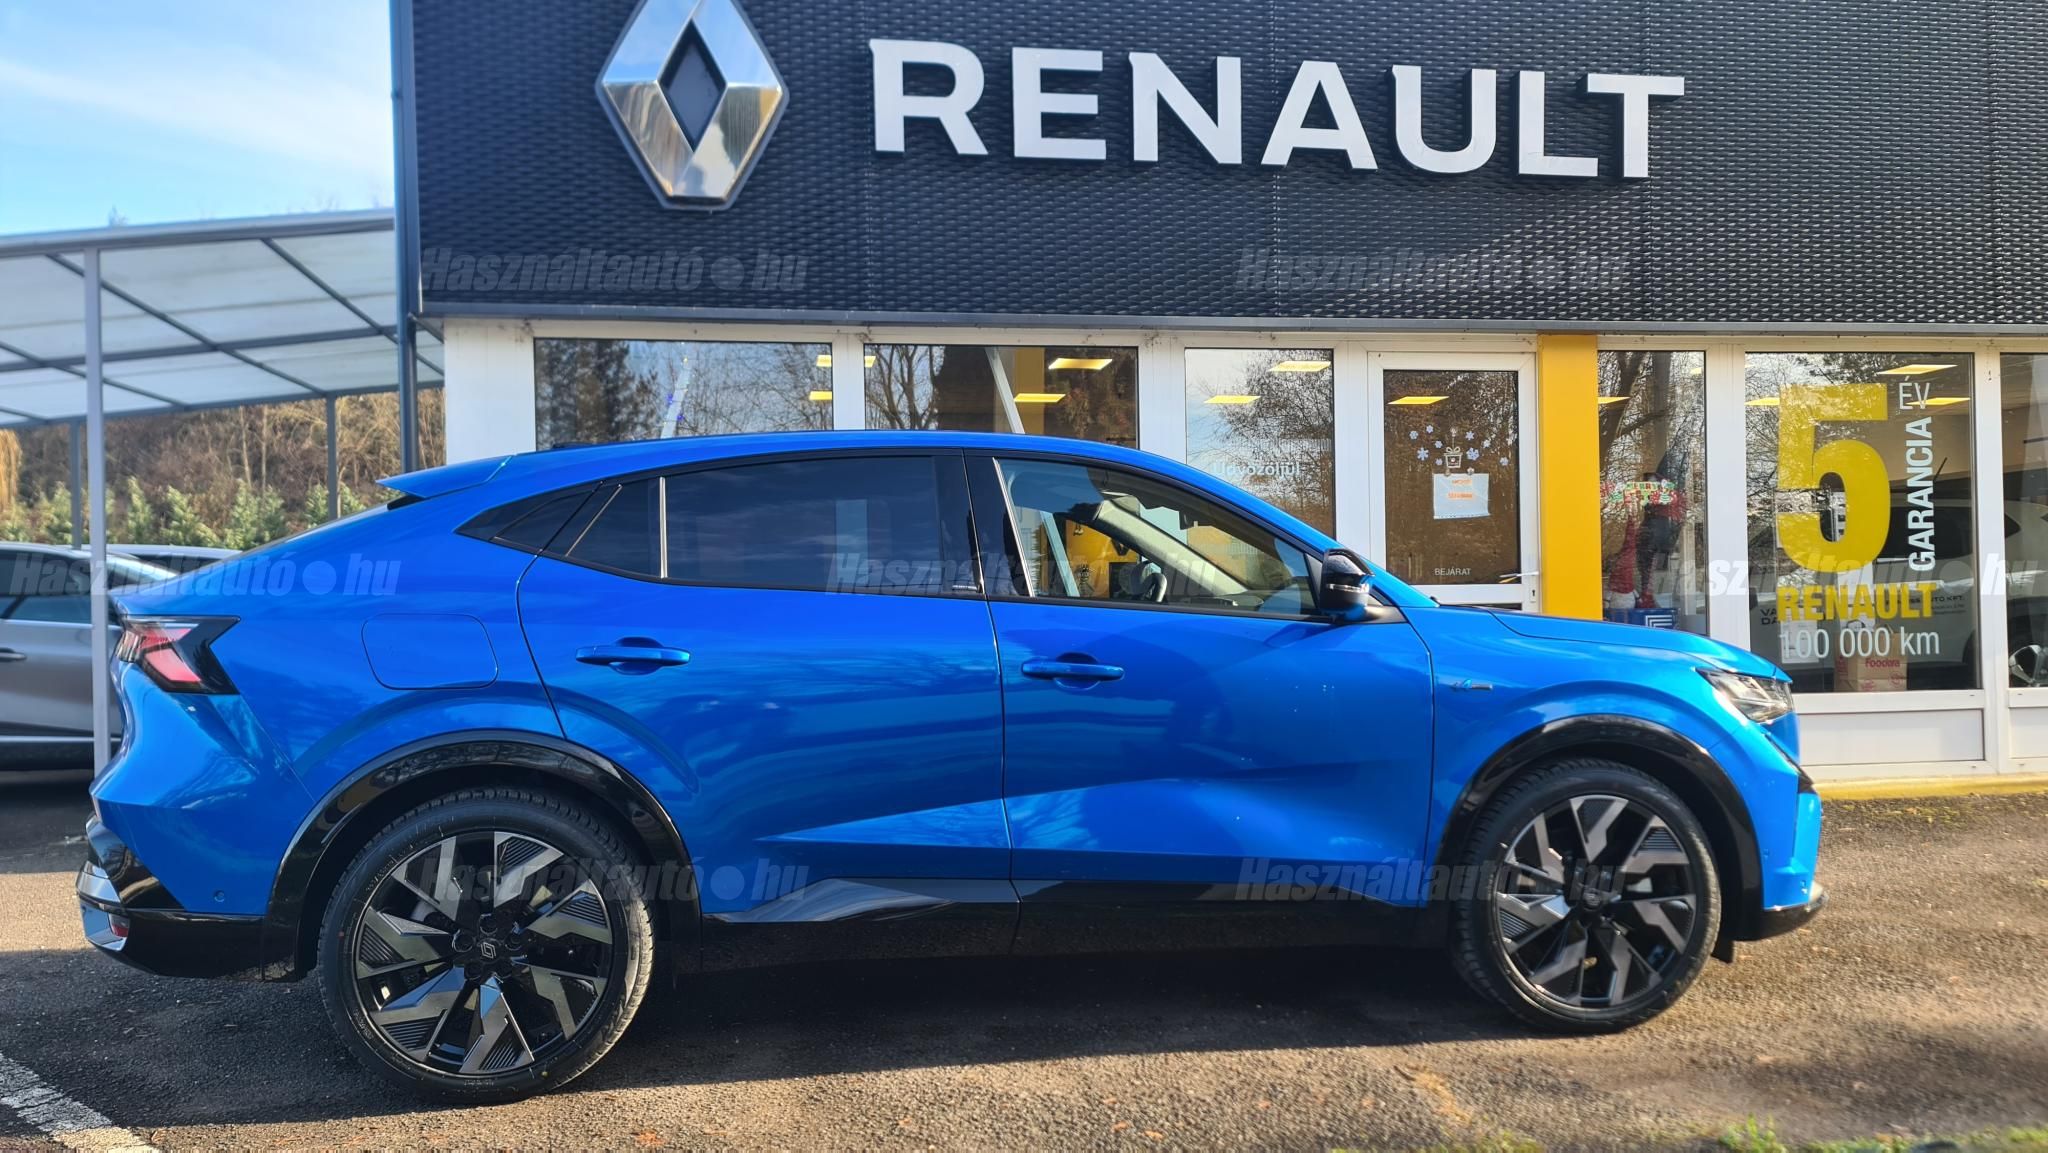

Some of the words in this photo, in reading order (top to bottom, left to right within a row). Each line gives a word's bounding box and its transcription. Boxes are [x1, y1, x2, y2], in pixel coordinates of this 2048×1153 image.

[869, 38, 1685, 179] RENAULT
[1776, 383, 1891, 574] 5
[1899, 376, 1931, 411] ÉV
[1905, 416, 1936, 572] GARANCIA
[1434, 566, 1471, 576] BEJÁRAT
[1776, 583, 1937, 622] RENAULT
[1779, 628, 1830, 659] 100
[1839, 627, 1891, 658] 000
[1900, 626, 1940, 656] km
